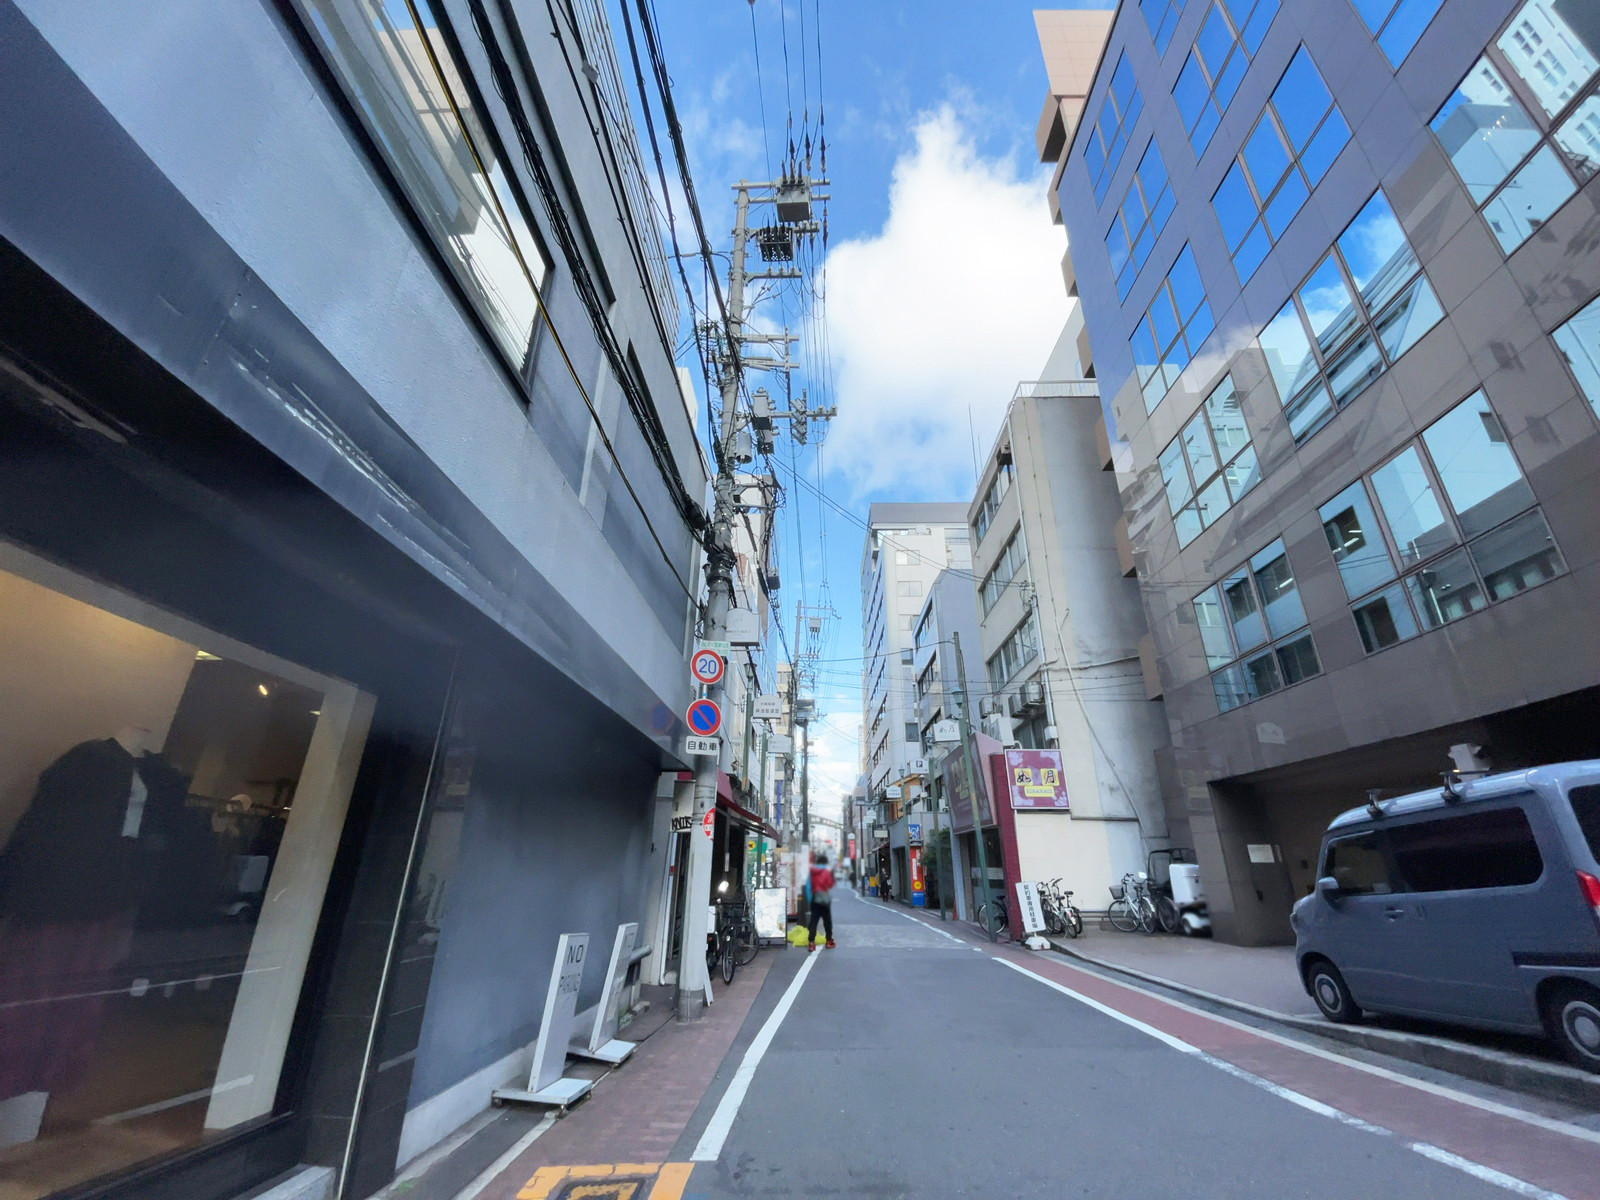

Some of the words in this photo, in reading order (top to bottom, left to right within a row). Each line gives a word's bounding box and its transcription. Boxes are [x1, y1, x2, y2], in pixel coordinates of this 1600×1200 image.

[698, 658, 717, 675] 20
[687, 740, 718, 751] 自動車
[567, 944, 584, 965] NO
